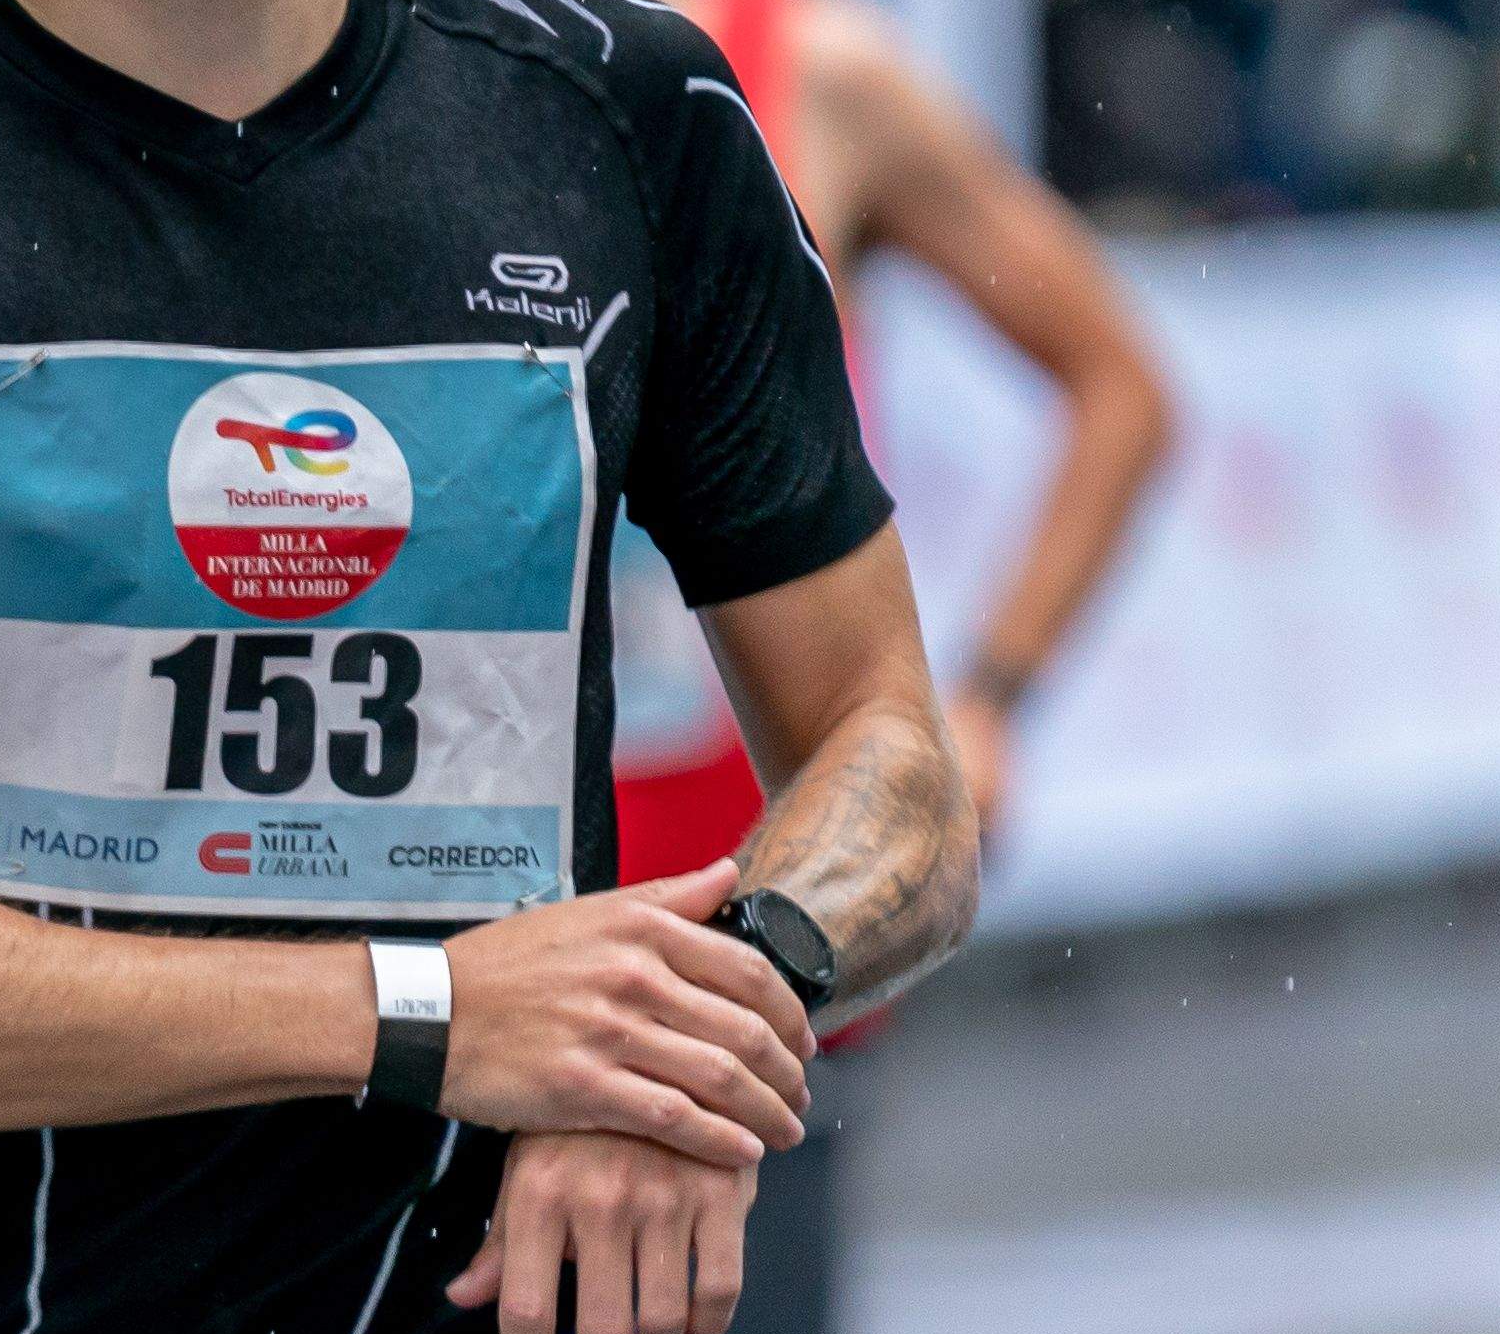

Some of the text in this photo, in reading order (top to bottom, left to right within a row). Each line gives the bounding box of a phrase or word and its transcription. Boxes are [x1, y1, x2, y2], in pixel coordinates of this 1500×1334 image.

[464, 287, 592, 332] Kalenji
[223, 487, 369, 512] TotalEnergies
[259, 533, 328, 553] MILLA
[232, 578, 350, 599] DE MADRID
[150, 631, 422, 797] 153
[20, 825, 159, 864] MADRID
[259, 833, 338, 853] MILLA
[257, 856, 350, 877] URBANA
